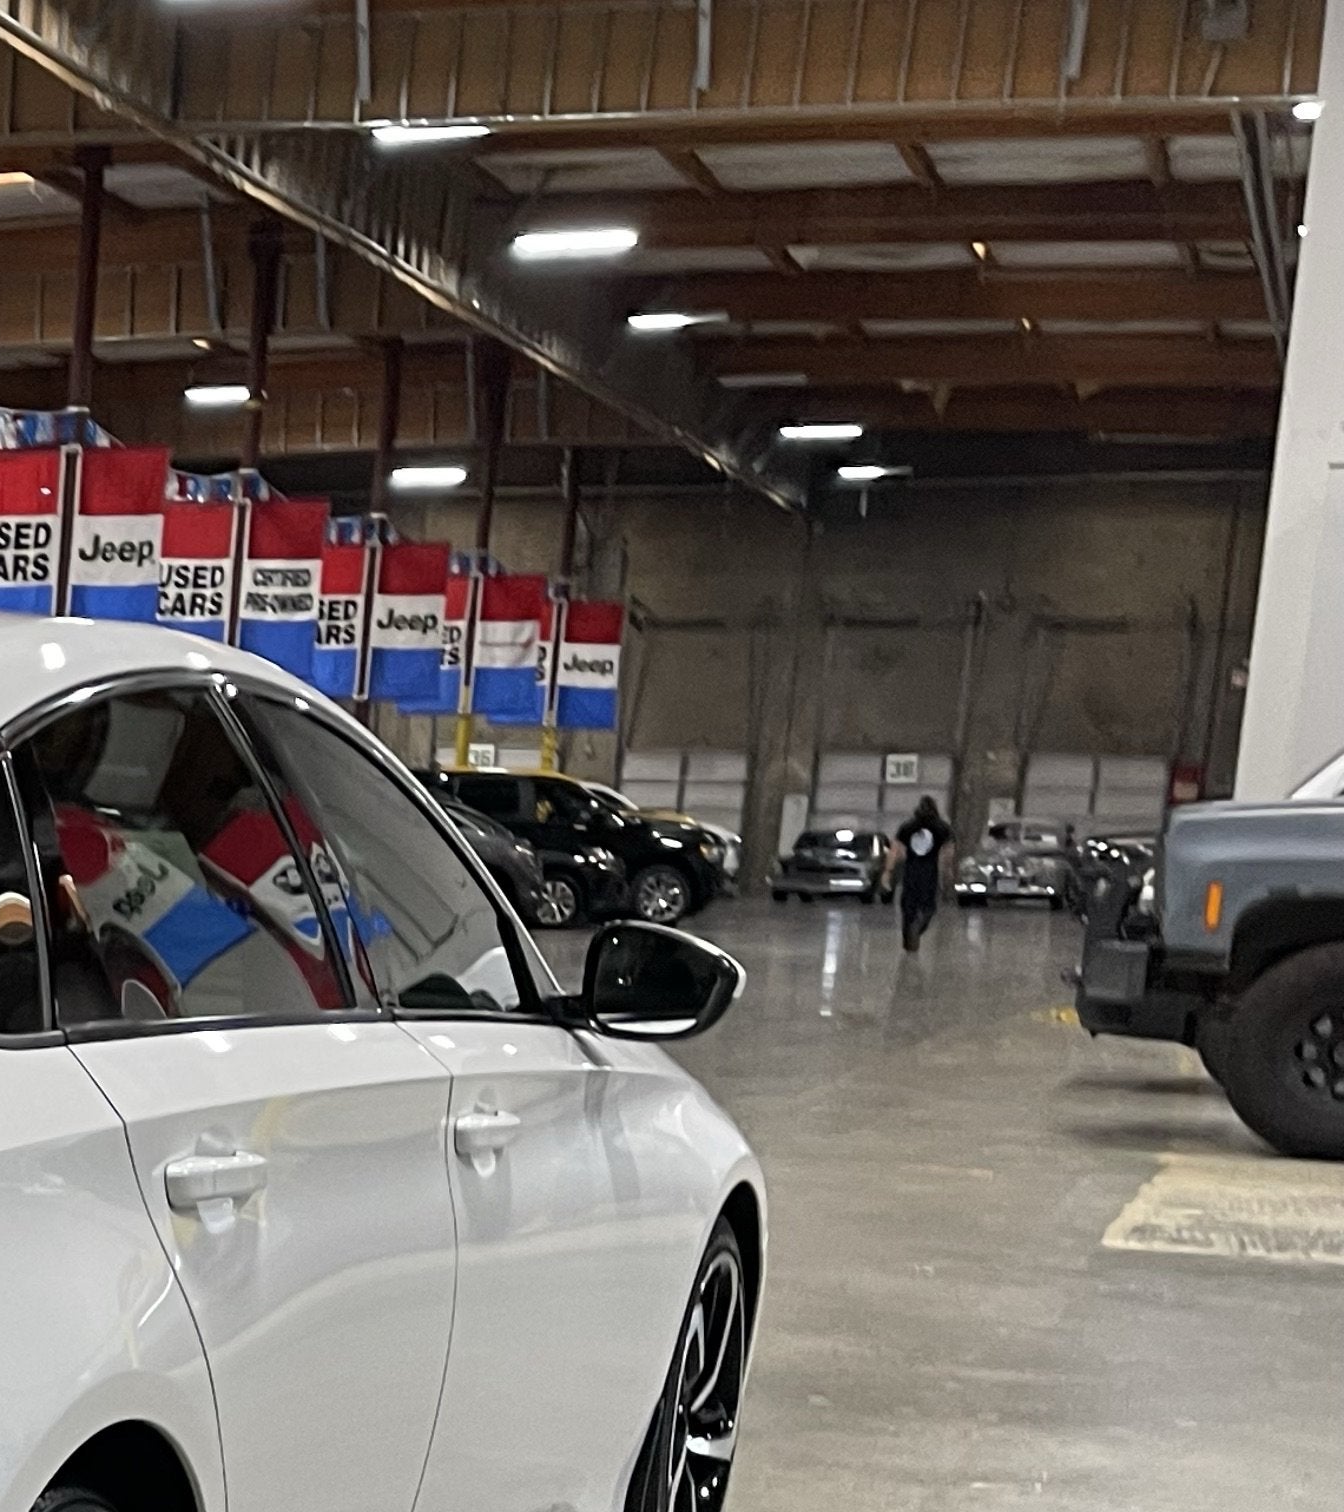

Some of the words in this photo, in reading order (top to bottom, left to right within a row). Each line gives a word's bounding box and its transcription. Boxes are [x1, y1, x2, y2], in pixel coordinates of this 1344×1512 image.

[78, 534, 154, 567] Jeep
[159, 564, 225, 589] USED
[158, 592, 224, 616] CARS
[377, 608, 438, 635] Jeep
